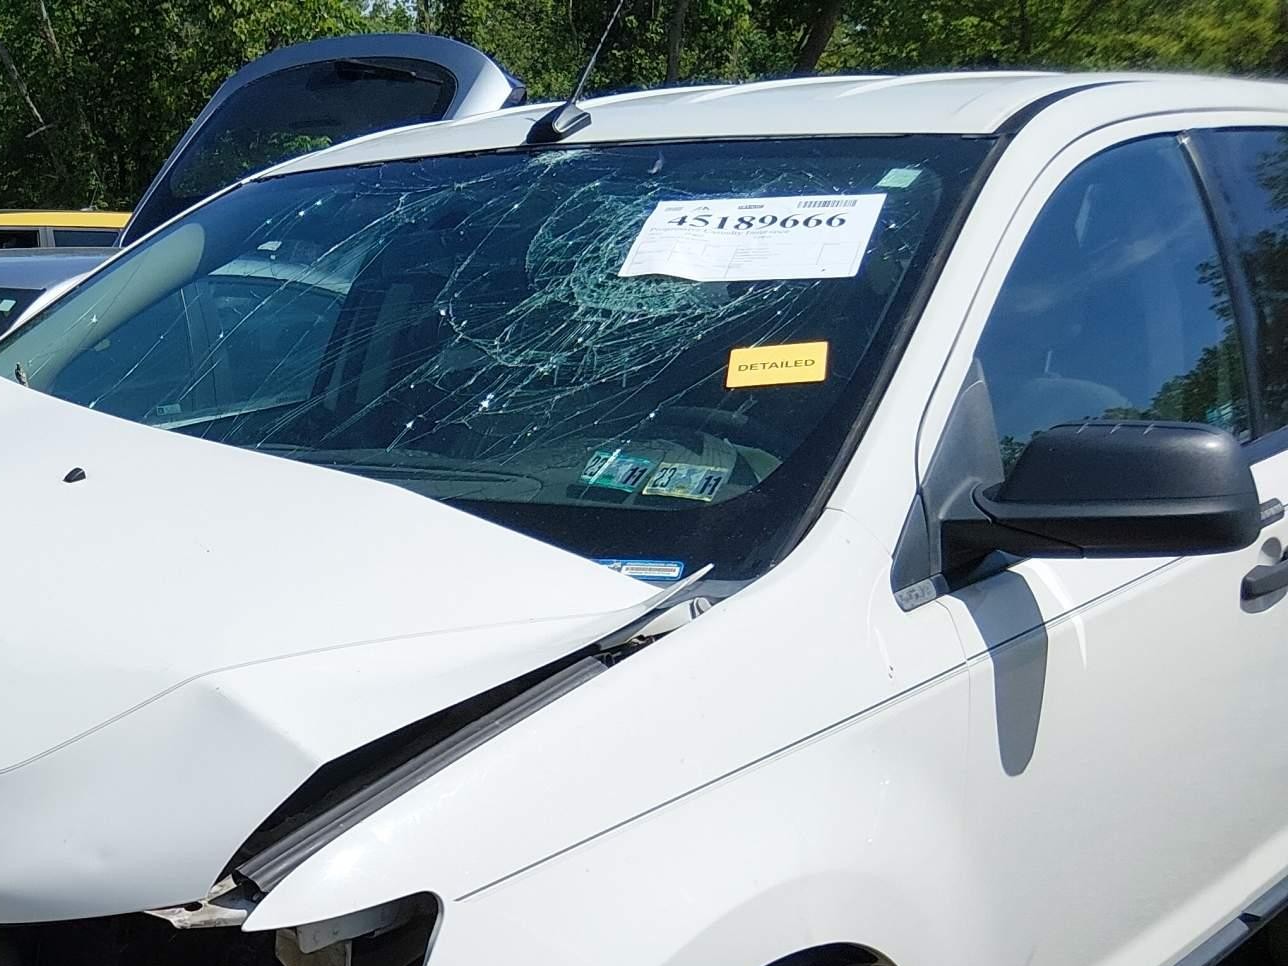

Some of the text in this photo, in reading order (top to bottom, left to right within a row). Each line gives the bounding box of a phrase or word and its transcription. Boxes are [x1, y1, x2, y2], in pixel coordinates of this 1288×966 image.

[667, 212, 849, 231] 45189666
[738, 359, 816, 372] DETAILED
[652, 467, 677, 488] 23
